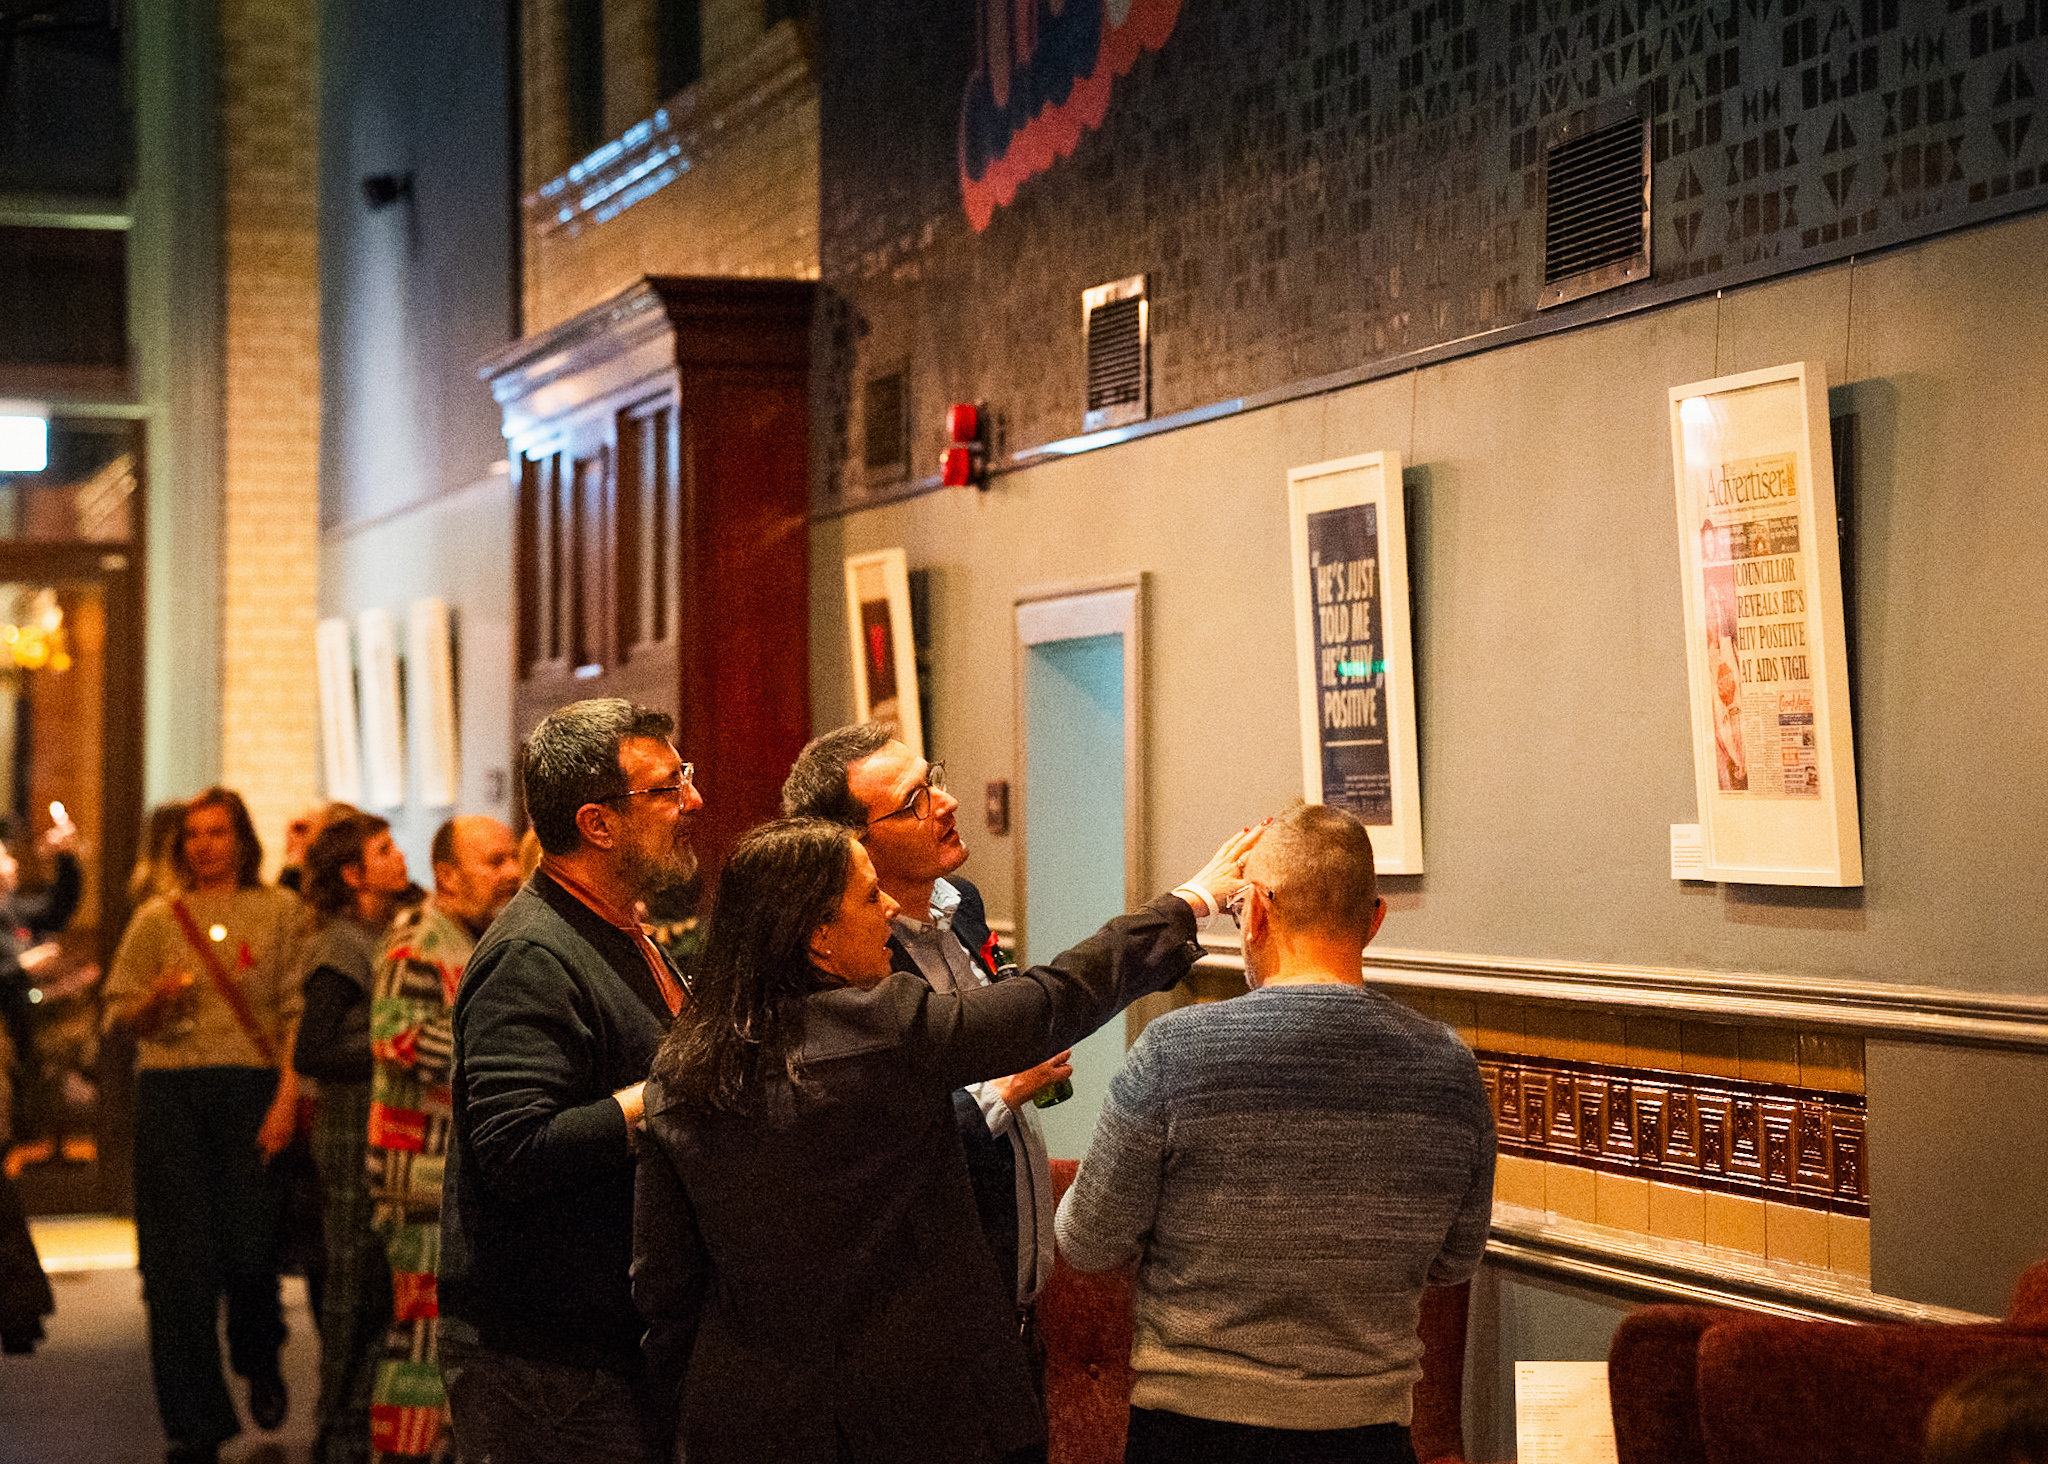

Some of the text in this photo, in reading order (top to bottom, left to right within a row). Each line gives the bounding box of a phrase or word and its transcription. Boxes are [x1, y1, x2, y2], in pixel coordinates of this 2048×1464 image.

[1706, 463, 1784, 507] Advertiser
[1347, 559, 1375, 600] JUST
[1735, 558, 1796, 586] COUNCILLOR
[1738, 590, 1805, 618] REVEALS HE'S
[1319, 601, 1370, 645] TOLD ME
[1739, 622, 1806, 650] HIV POSITIVE
[1742, 655, 1810, 683] AT AIDS VIGIL
[1324, 688, 1377, 728] POSITIVE
